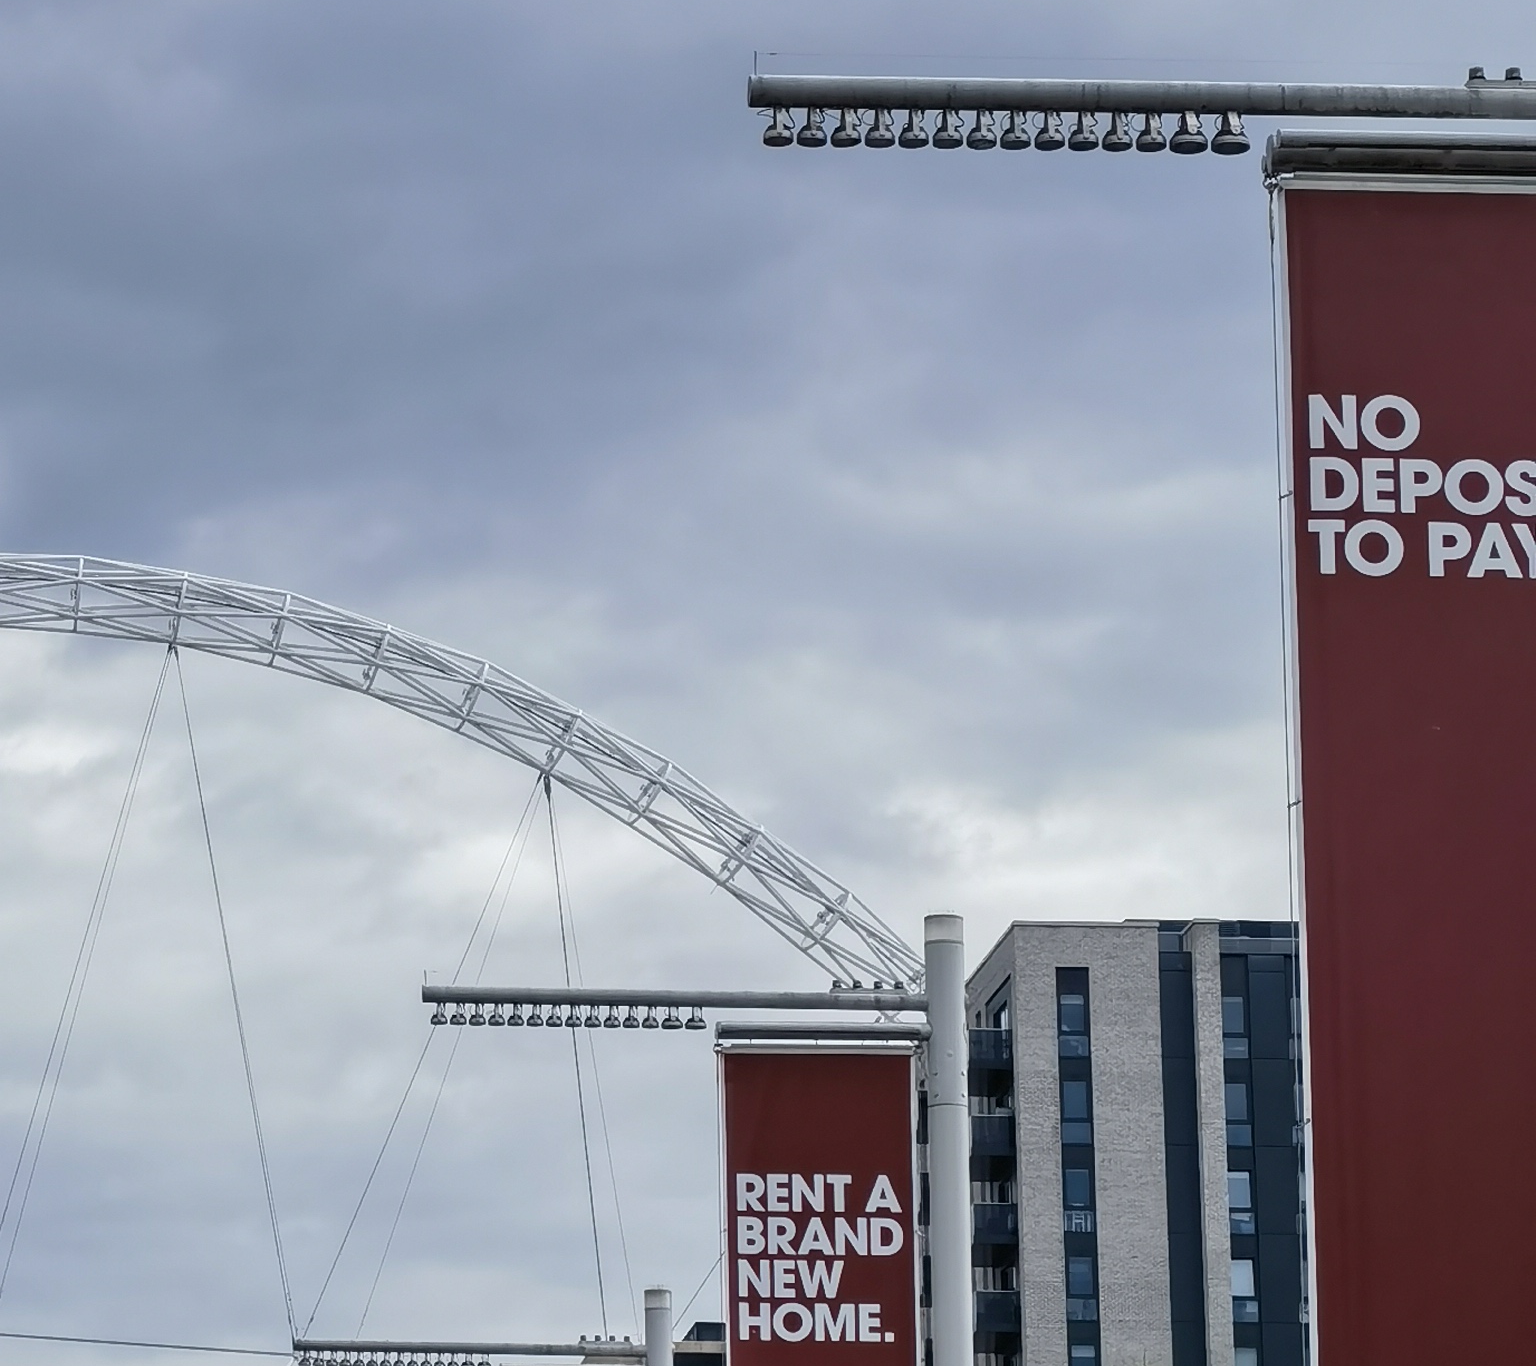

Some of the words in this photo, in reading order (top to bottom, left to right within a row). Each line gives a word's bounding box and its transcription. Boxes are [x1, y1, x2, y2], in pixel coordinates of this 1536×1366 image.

[1308, 394, 1420, 451] NO
[1309, 456, 1536, 516] DEPOS
[1308, 519, 1404, 577] TO
[736, 1173, 852, 1212] RENT
[865, 1174, 902, 1213] A
[737, 1216, 904, 1256] BRAND
[737, 1259, 844, 1299] NEW
[738, 1302, 895, 1342] HOME.
